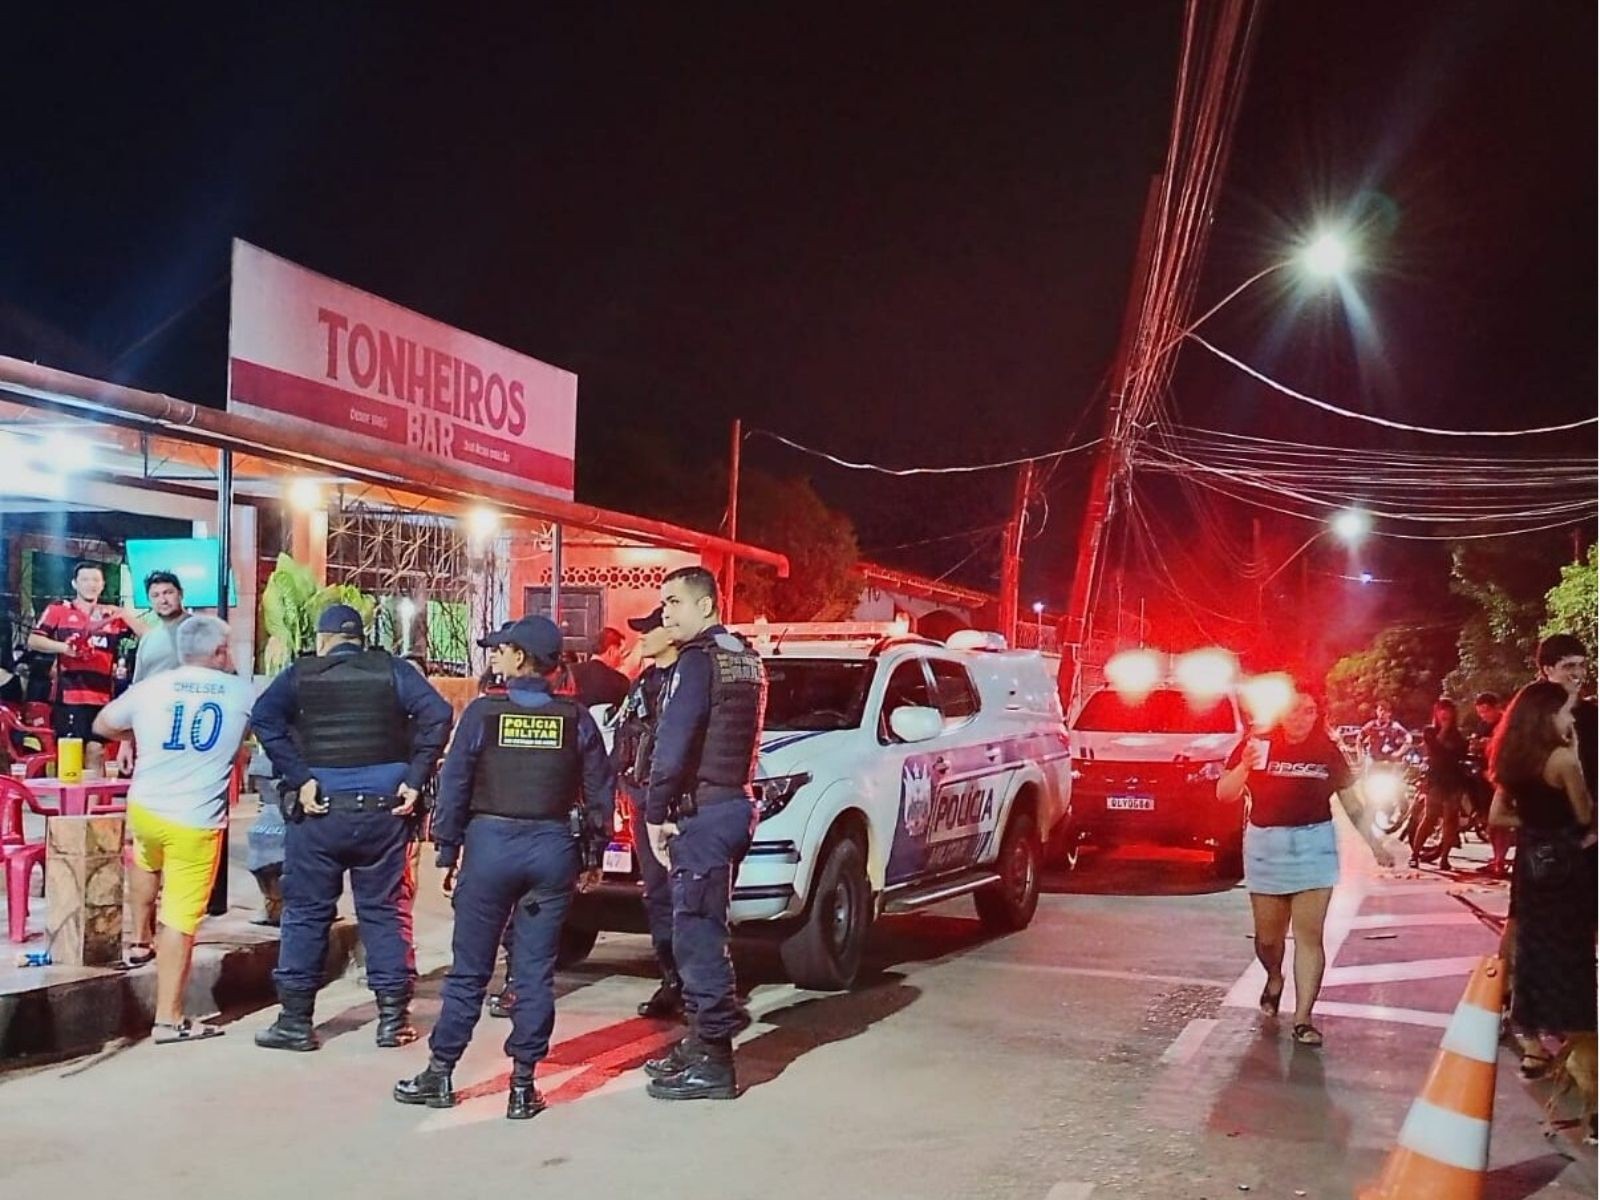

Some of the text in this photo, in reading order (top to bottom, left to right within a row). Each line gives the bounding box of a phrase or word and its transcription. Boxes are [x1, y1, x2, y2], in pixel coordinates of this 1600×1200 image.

[318, 307, 527, 437] TONHEIROS
[407, 408, 454, 457] BAR
[173, 682, 225, 694] CHELSEA
[162, 701, 223, 752] 10
[503, 728, 557, 739] MILITAR
[504, 717, 557, 729] POLÍCIA
[934, 785, 994, 832] POLÍCIA
